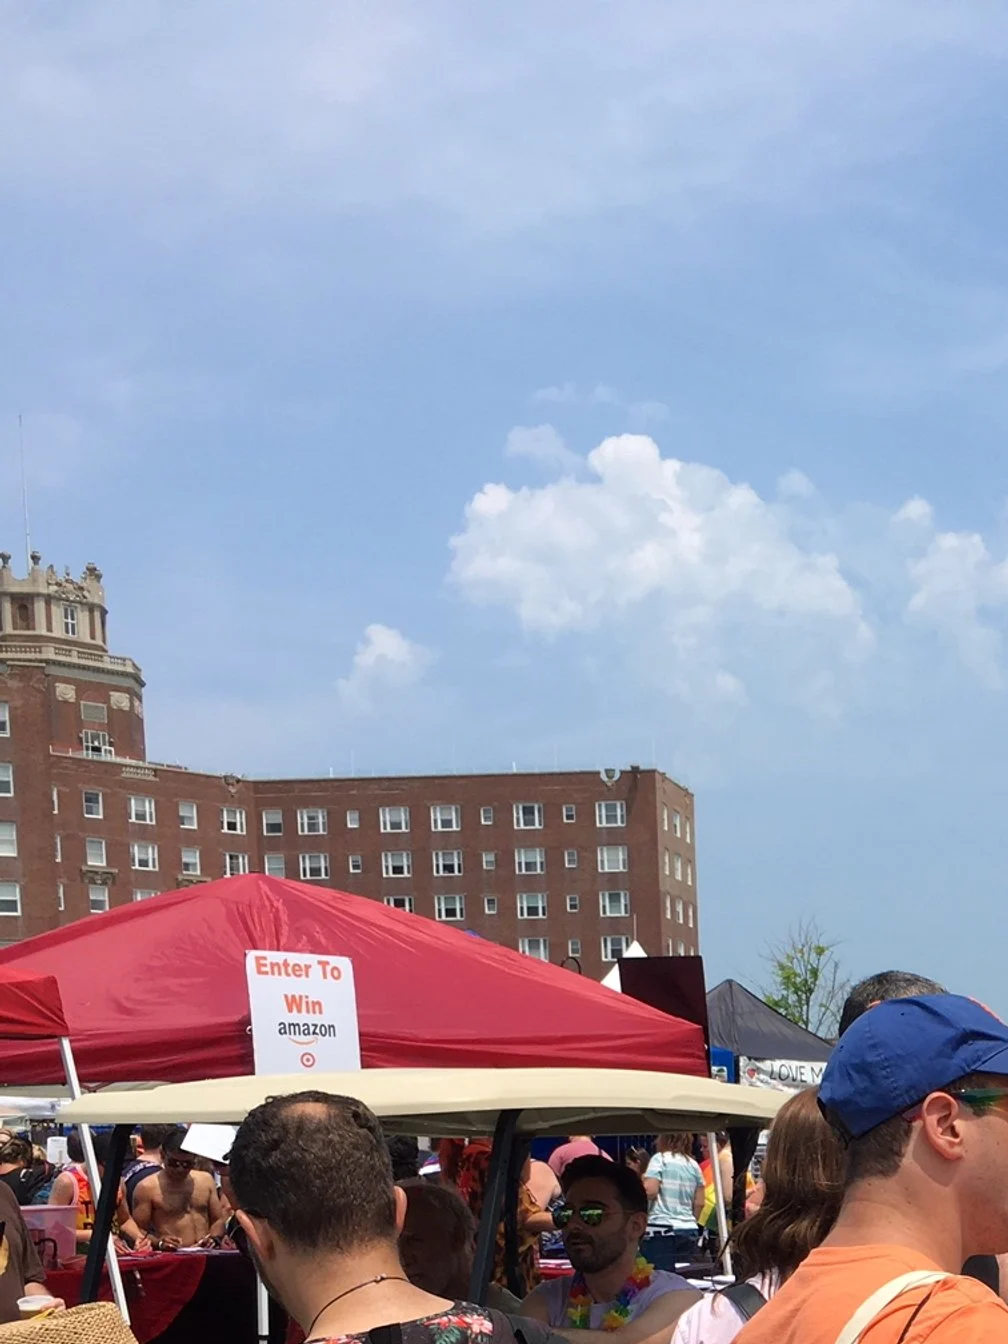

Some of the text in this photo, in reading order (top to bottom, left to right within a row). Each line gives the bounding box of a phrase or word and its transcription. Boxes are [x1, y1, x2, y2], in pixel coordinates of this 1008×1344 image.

[254, 955, 342, 980] Enter To
[284, 993, 323, 1015] Win
[278, 1021, 336, 1038] amazon
[769, 1062, 808, 1083] LOVE
